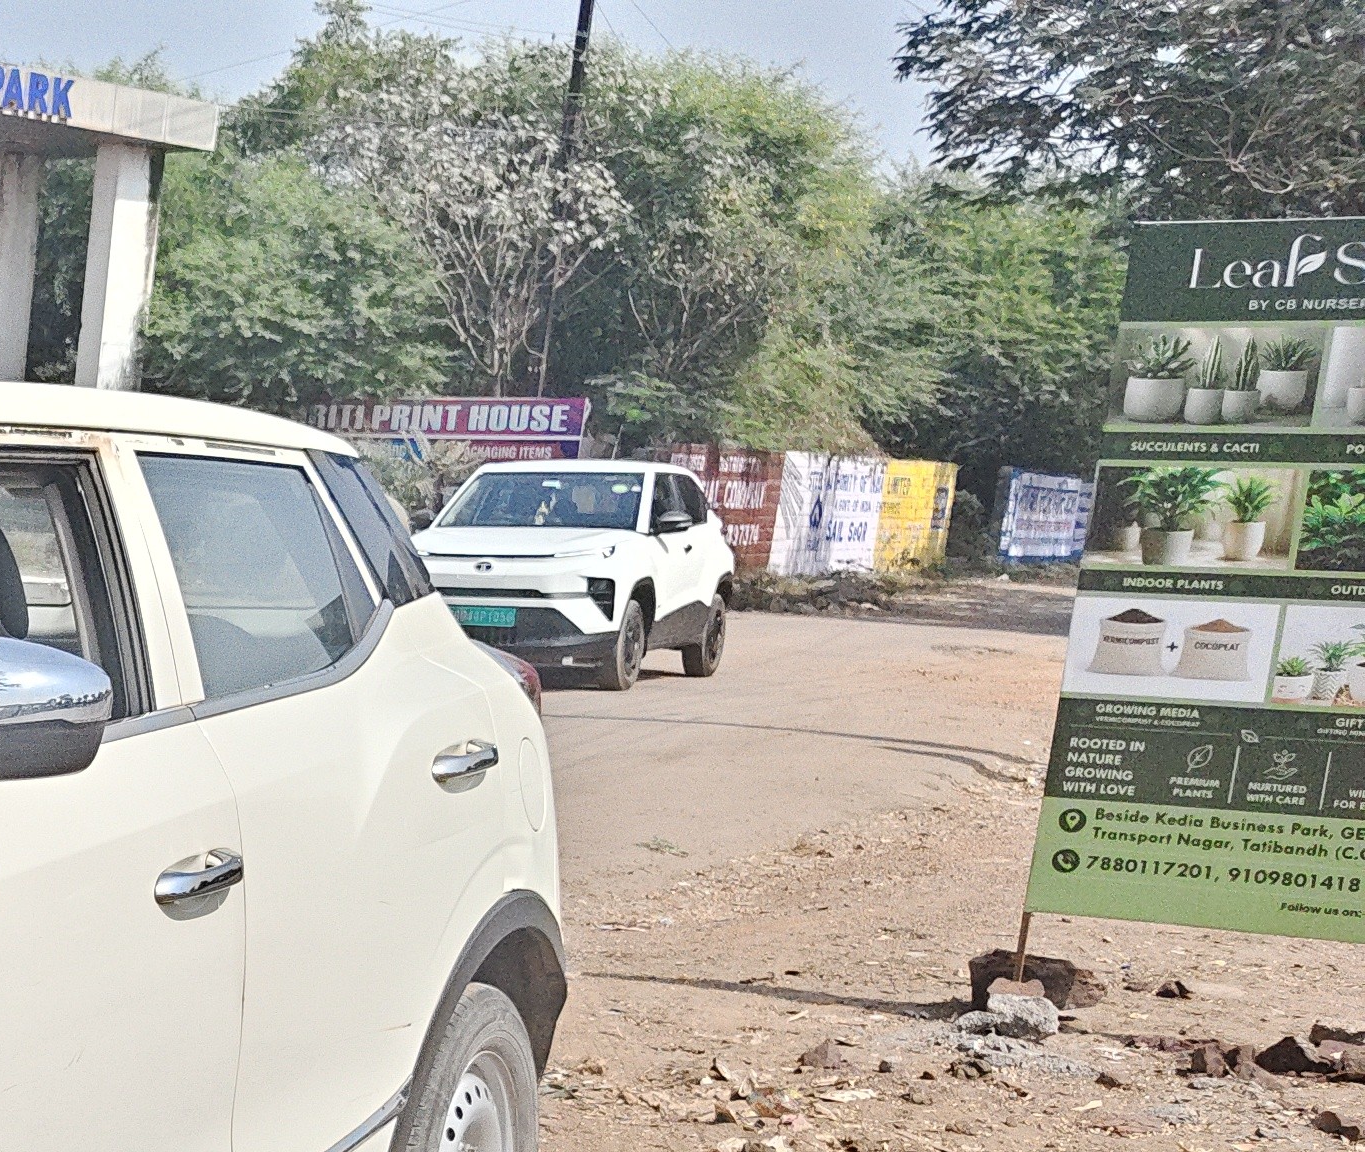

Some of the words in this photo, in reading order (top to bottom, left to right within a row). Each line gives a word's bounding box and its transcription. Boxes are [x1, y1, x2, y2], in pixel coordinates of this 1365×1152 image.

[1188, 233, 1328, 290] Leaf
[1248, 299, 1270, 311] BY
[1274, 299, 1296, 310] CB
[371, 404, 461, 432] PRINT
[467, 404, 570, 433] HOUSE
[518, 446, 553, 460] ITEMS
[1129, 441, 1208, 453] SUCCULENTS
[1209, 442, 1219, 453] &
[1222, 442, 1260, 454] CACTI
[1122, 576, 1173, 588] INDOOR
[1175, 579, 1224, 591] PLANTS
[1095, 703, 1157, 717] GROWING
[1159, 707, 1200, 719] MEDIA
[1335, 717, 1365, 729] GIFT
[1069, 737, 1126, 751] ROOTED
[1129, 741, 1146, 752] IN
[1067, 752, 1122, 766] NATURE
[1064, 766, 1134, 781] GROWING
[1062, 781, 1097, 794] WITH
[1099, 784, 1136, 796] LOVE
[1169, 776, 1220, 788] PREMIUM
[1248, 782, 1307, 794] NURTURED
[1172, 788, 1213, 799] PLANTS
[1246, 793, 1274, 803] WITH
[1275, 795, 1306, 806] CARE
[1333, 799, 1356, 809] FOR
[1095, 807, 1150, 824] Beside
[1155, 811, 1204, 828] Kedia
[1210, 815, 1285, 834] Business
[1290, 822, 1334, 840] Park,
[1092, 826, 1172, 845] Transport
[1176, 833, 1235, 851] Nagar,
[1241, 838, 1329, 858] Tatibandh
[1085, 855, 1220, 883] 7880117201,
[1228, 867, 1361, 893] 9109801418
[1280, 902, 1322, 915] Follow
[1323, 907, 1340, 916] us
